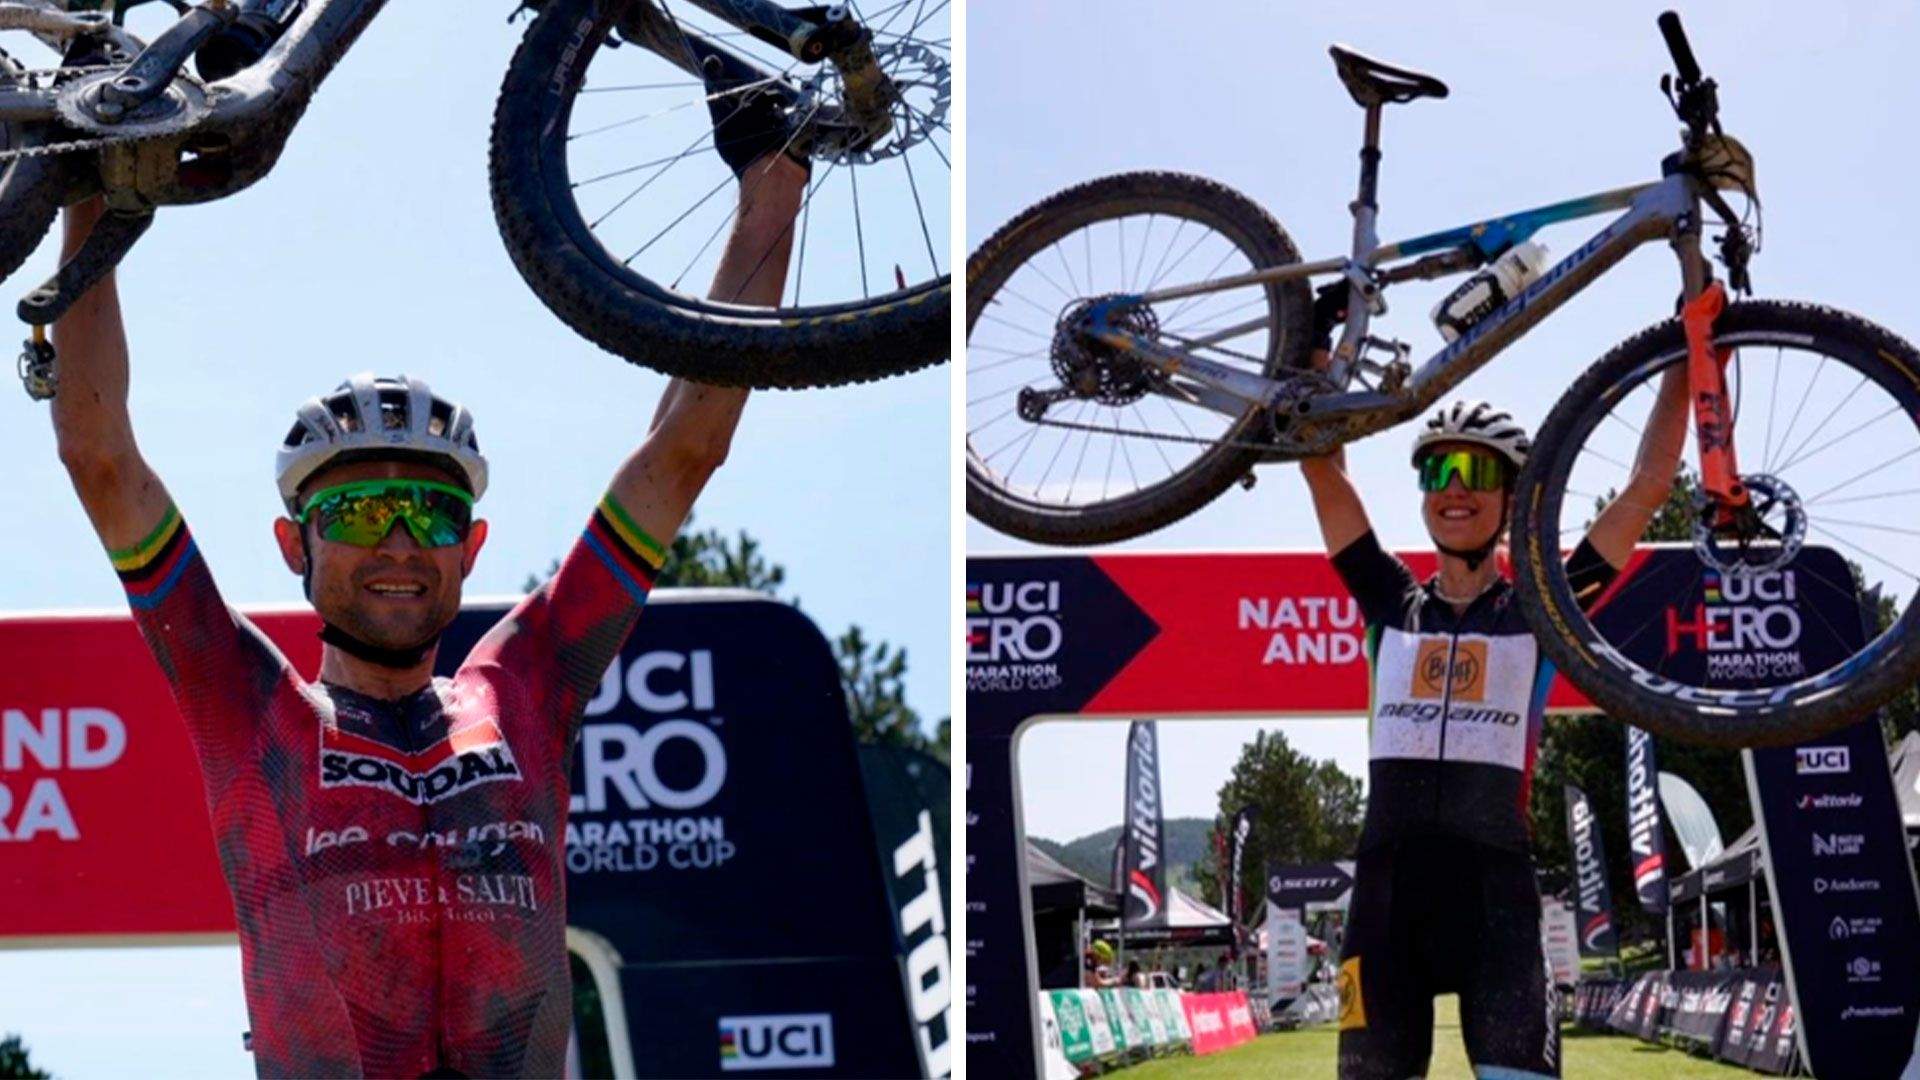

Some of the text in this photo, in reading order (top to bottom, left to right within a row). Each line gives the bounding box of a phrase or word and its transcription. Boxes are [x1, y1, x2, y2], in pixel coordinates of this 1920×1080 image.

[549, 17, 594, 97] URSUS
[982, 580, 1060, 614] UCI
[1721, 569, 1797, 602] UCI
[1238, 596, 1365, 630] NATU
[1666, 602, 1802, 658] HERO
[1262, 632, 1370, 666] AND
[1707, 651, 1800, 667] MARATHON
[1027, 674, 1062, 690] CUP
[1708, 663, 1769, 680] WORLD
[2, 706, 127, 771] ND
[322, 747, 517, 799] SOUDAL
[1805, 750, 1847, 769] UCI
[1131, 721, 1159, 870] vittoria
[667, 840, 736, 870] CUP
[346, 877, 431, 914] PIEVE
[456, 874, 537, 911] SALTI
[1281, 878, 1340, 889] SCOTT
[1830, 878, 1880, 891] Andorra
[741, 1025, 822, 1058] UCI
